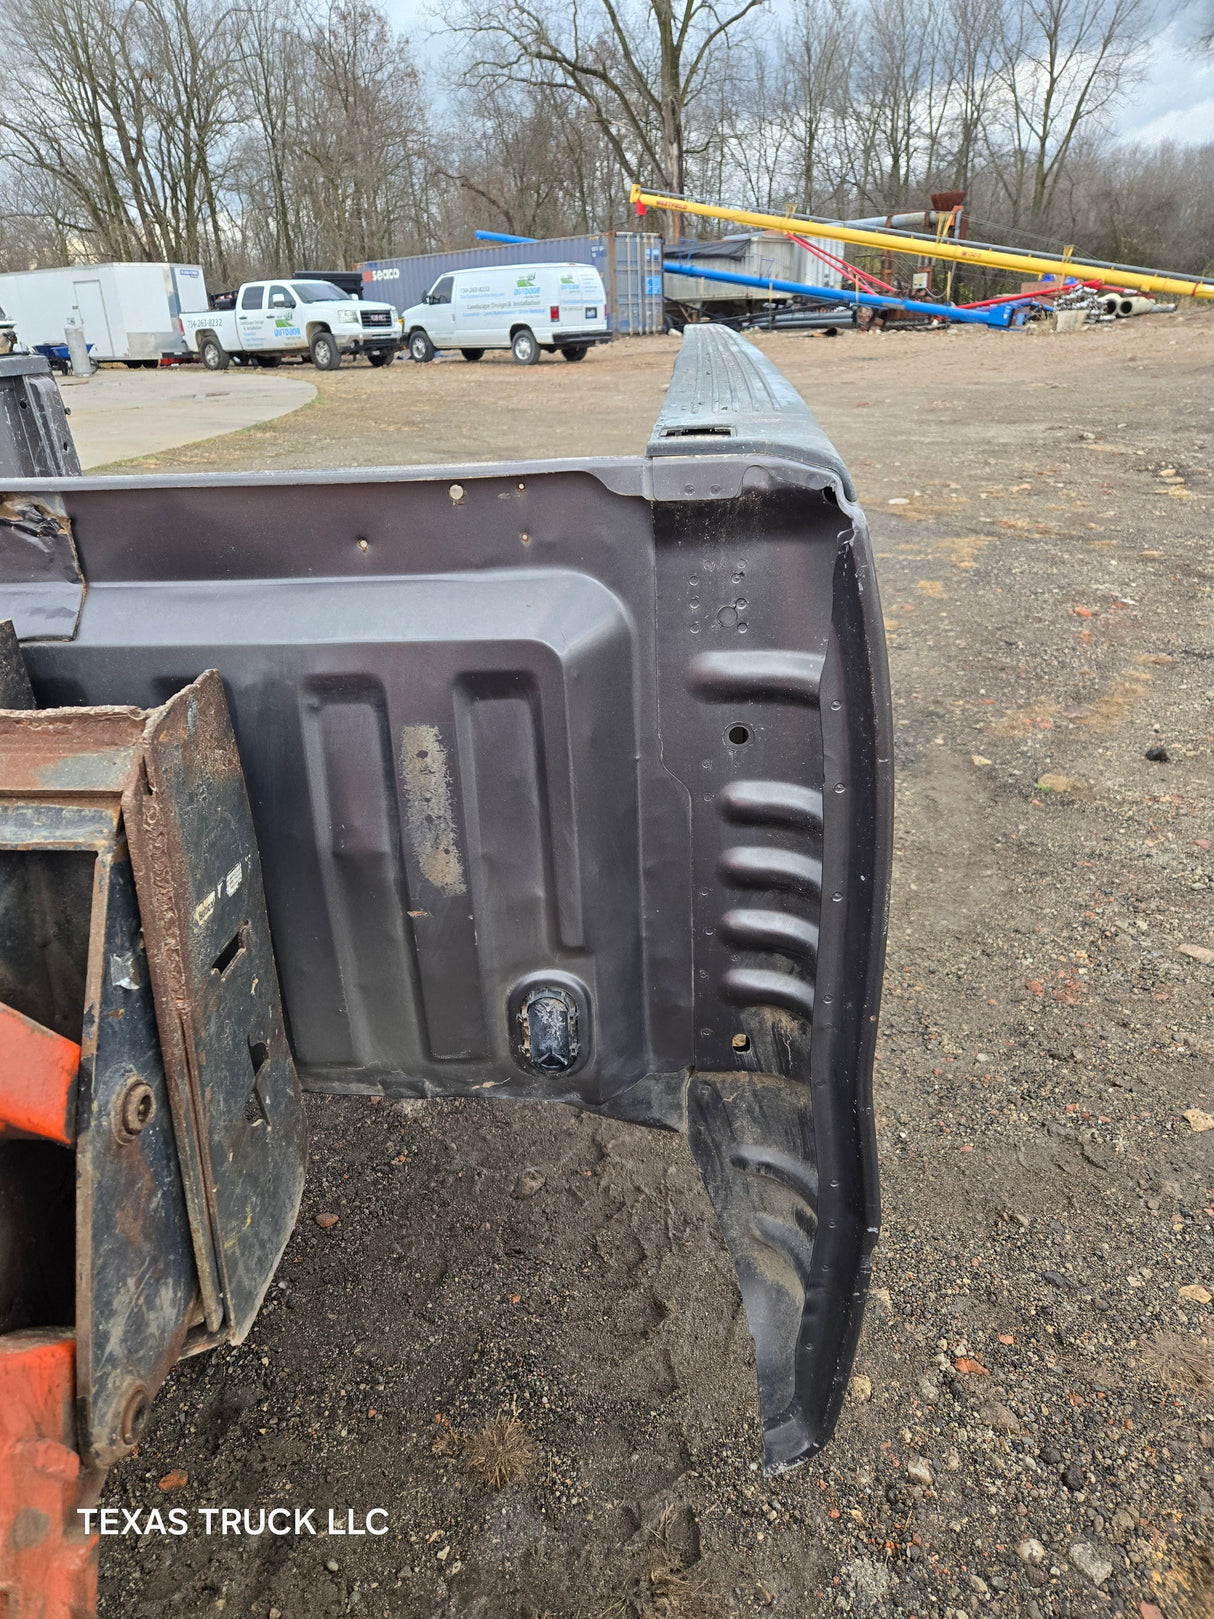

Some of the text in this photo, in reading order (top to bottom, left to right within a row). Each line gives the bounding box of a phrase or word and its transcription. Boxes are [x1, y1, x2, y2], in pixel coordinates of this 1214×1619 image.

[372, 268, 400, 281] seaco
[513, 287, 540, 296] OUTDOOR
[274, 328, 301, 337] OUTDOOR
